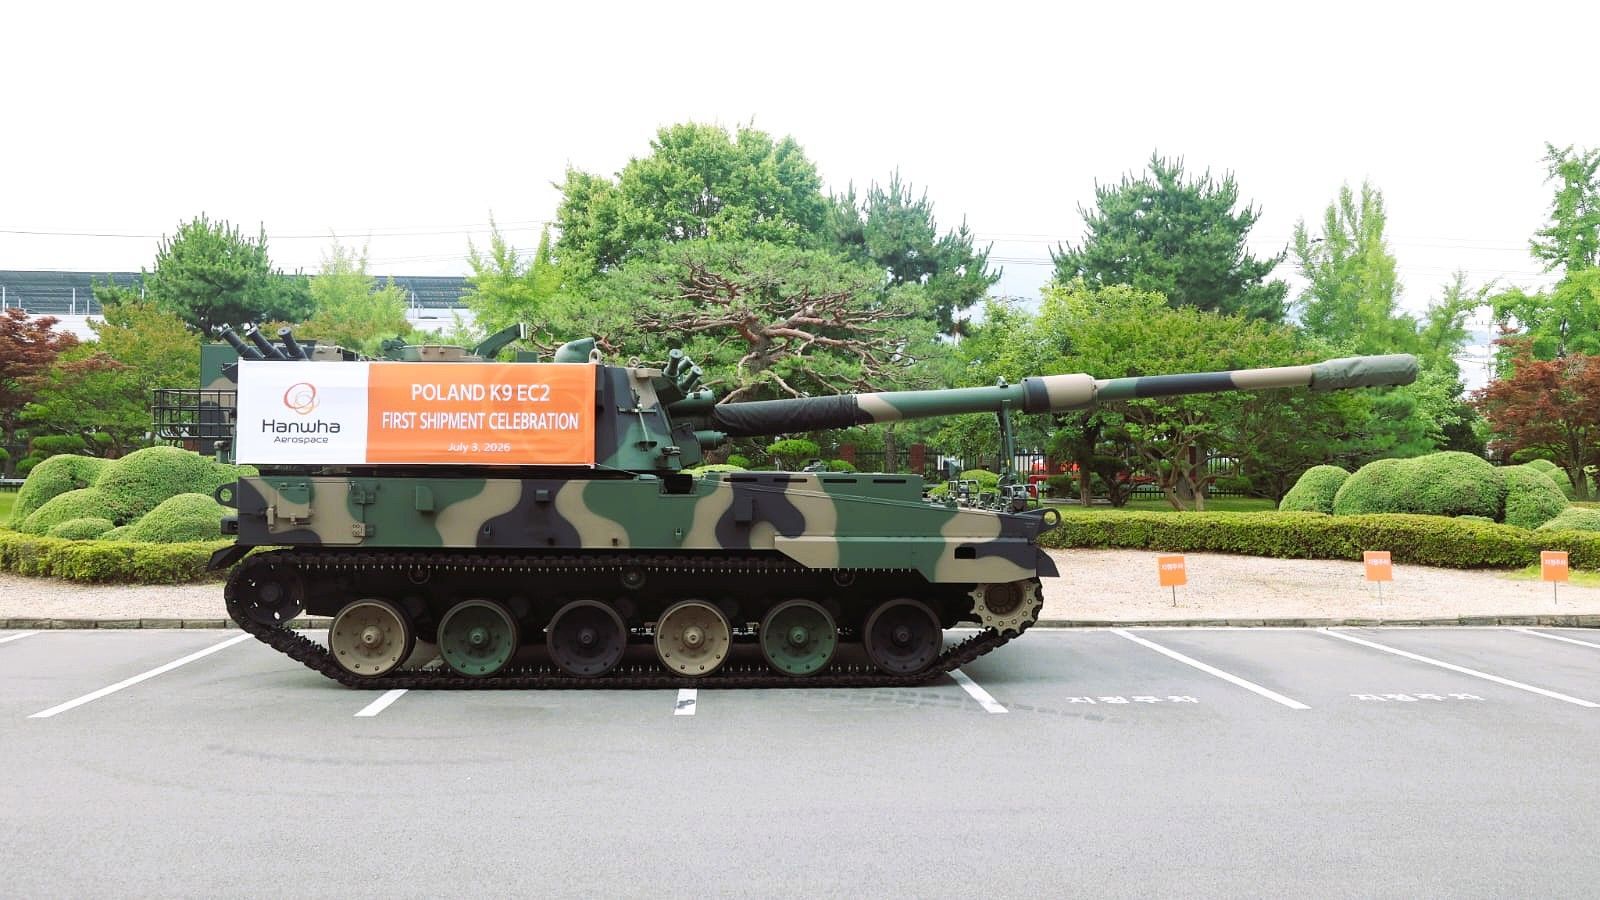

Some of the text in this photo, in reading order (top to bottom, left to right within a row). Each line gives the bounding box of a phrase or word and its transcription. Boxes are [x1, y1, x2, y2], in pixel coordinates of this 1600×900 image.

[411, 383, 550, 402] POLAND K9 EC2
[262, 419, 341, 433] Hanwha
[382, 412, 579, 430] FIRST SHIPMENT CELEBRATION
[273, 436, 329, 444] Aerospace
[448, 442, 511, 452] July 3, 2026
